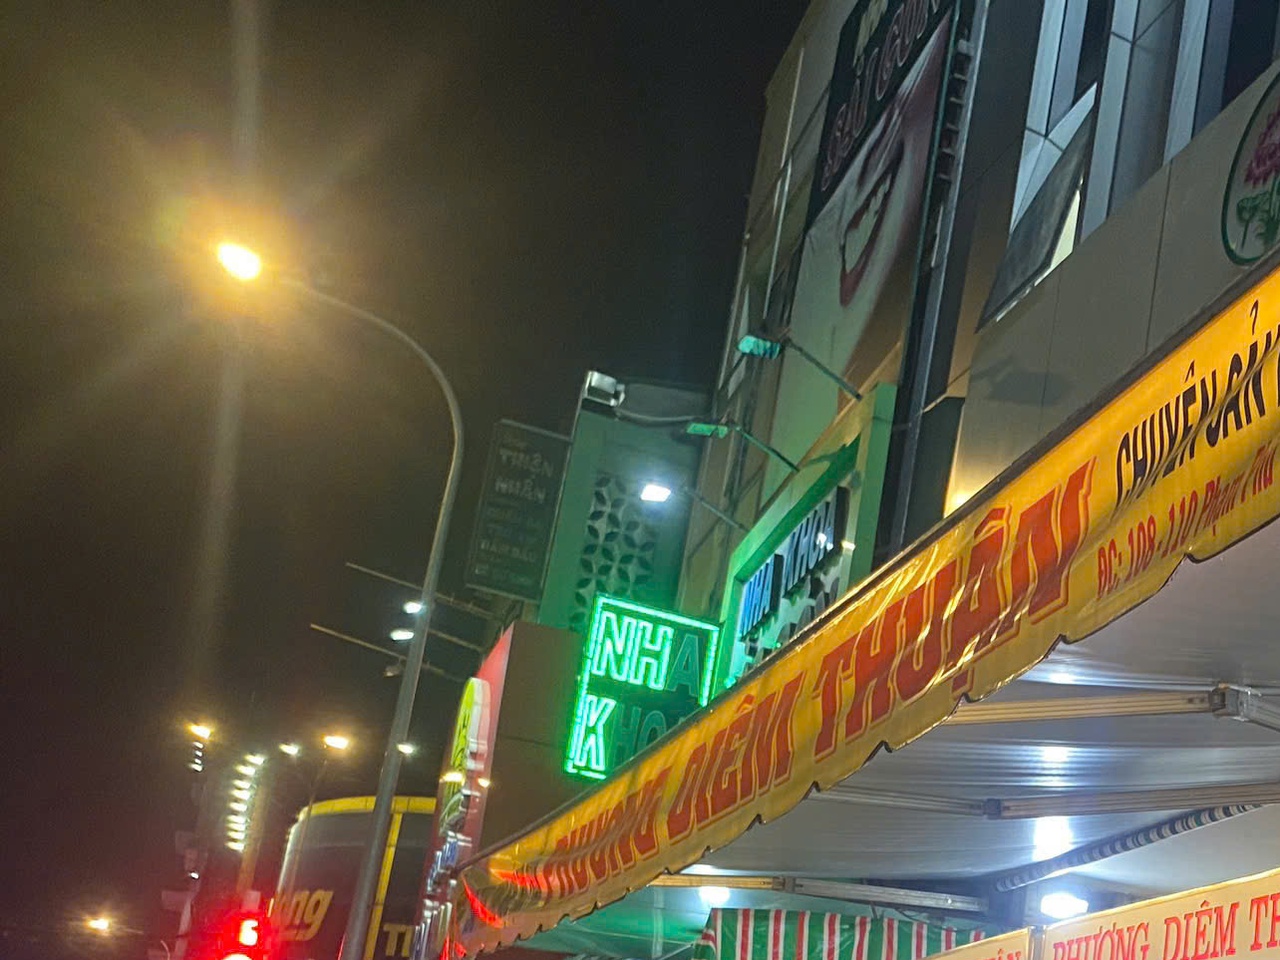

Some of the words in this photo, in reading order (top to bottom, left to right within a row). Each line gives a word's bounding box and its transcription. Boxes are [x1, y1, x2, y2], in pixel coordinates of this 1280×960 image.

[813, 455, 1100, 758] THUẬN
[592, 609, 700, 698] NHA
[573, 694, 690, 772] KHO
